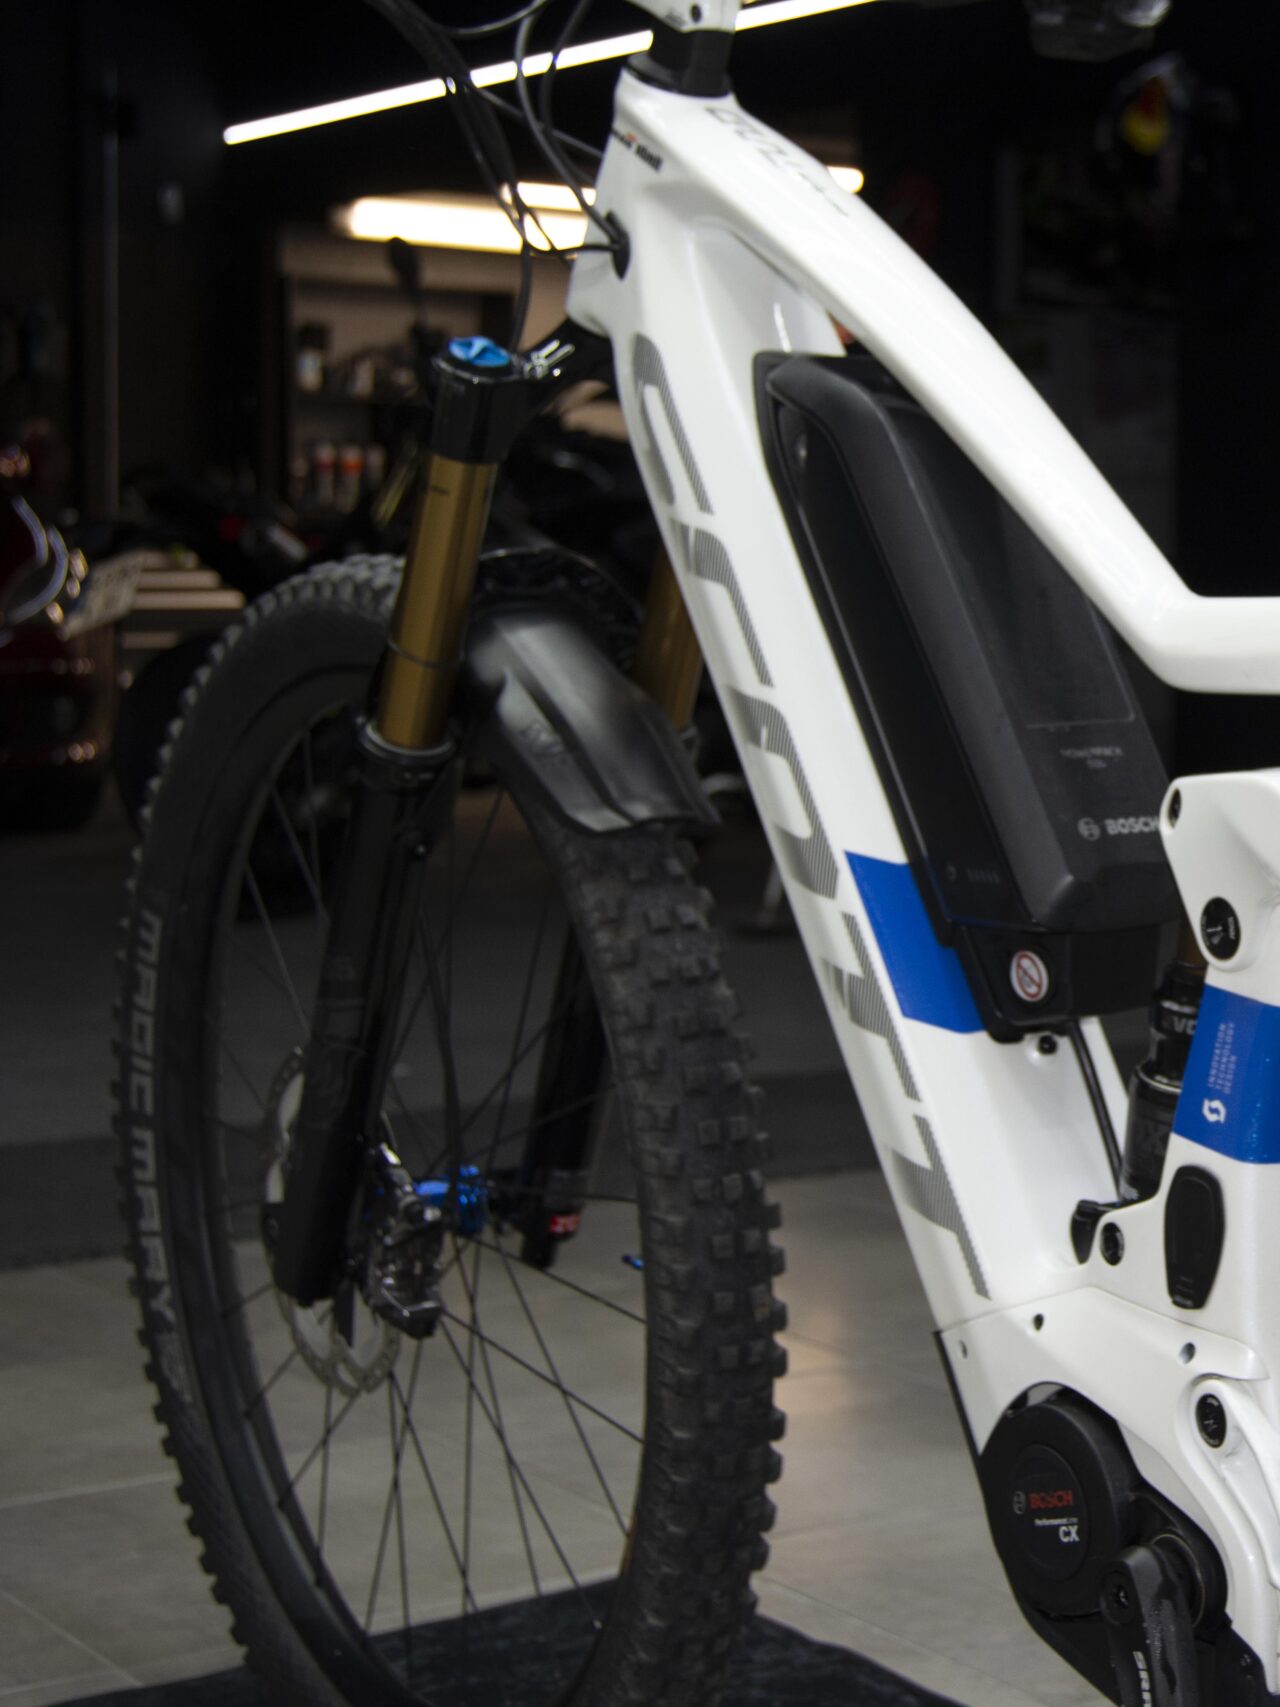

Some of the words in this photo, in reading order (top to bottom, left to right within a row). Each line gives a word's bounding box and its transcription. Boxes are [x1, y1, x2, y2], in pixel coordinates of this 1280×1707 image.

[1104, 816, 1161, 836] BOSCH
[130, 908, 163, 1116] MAGIC
[1207, 1022, 1227, 1088] INNOVATION
[1215, 1022, 1235, 1090] TECHNOLOGY
[1222, 1055, 1237, 1095] DESIGN
[131, 1127, 177, 1325] MARY
[1028, 1490, 1073, 1510] BOSCH
[1059, 1524, 1081, 1543] CX
